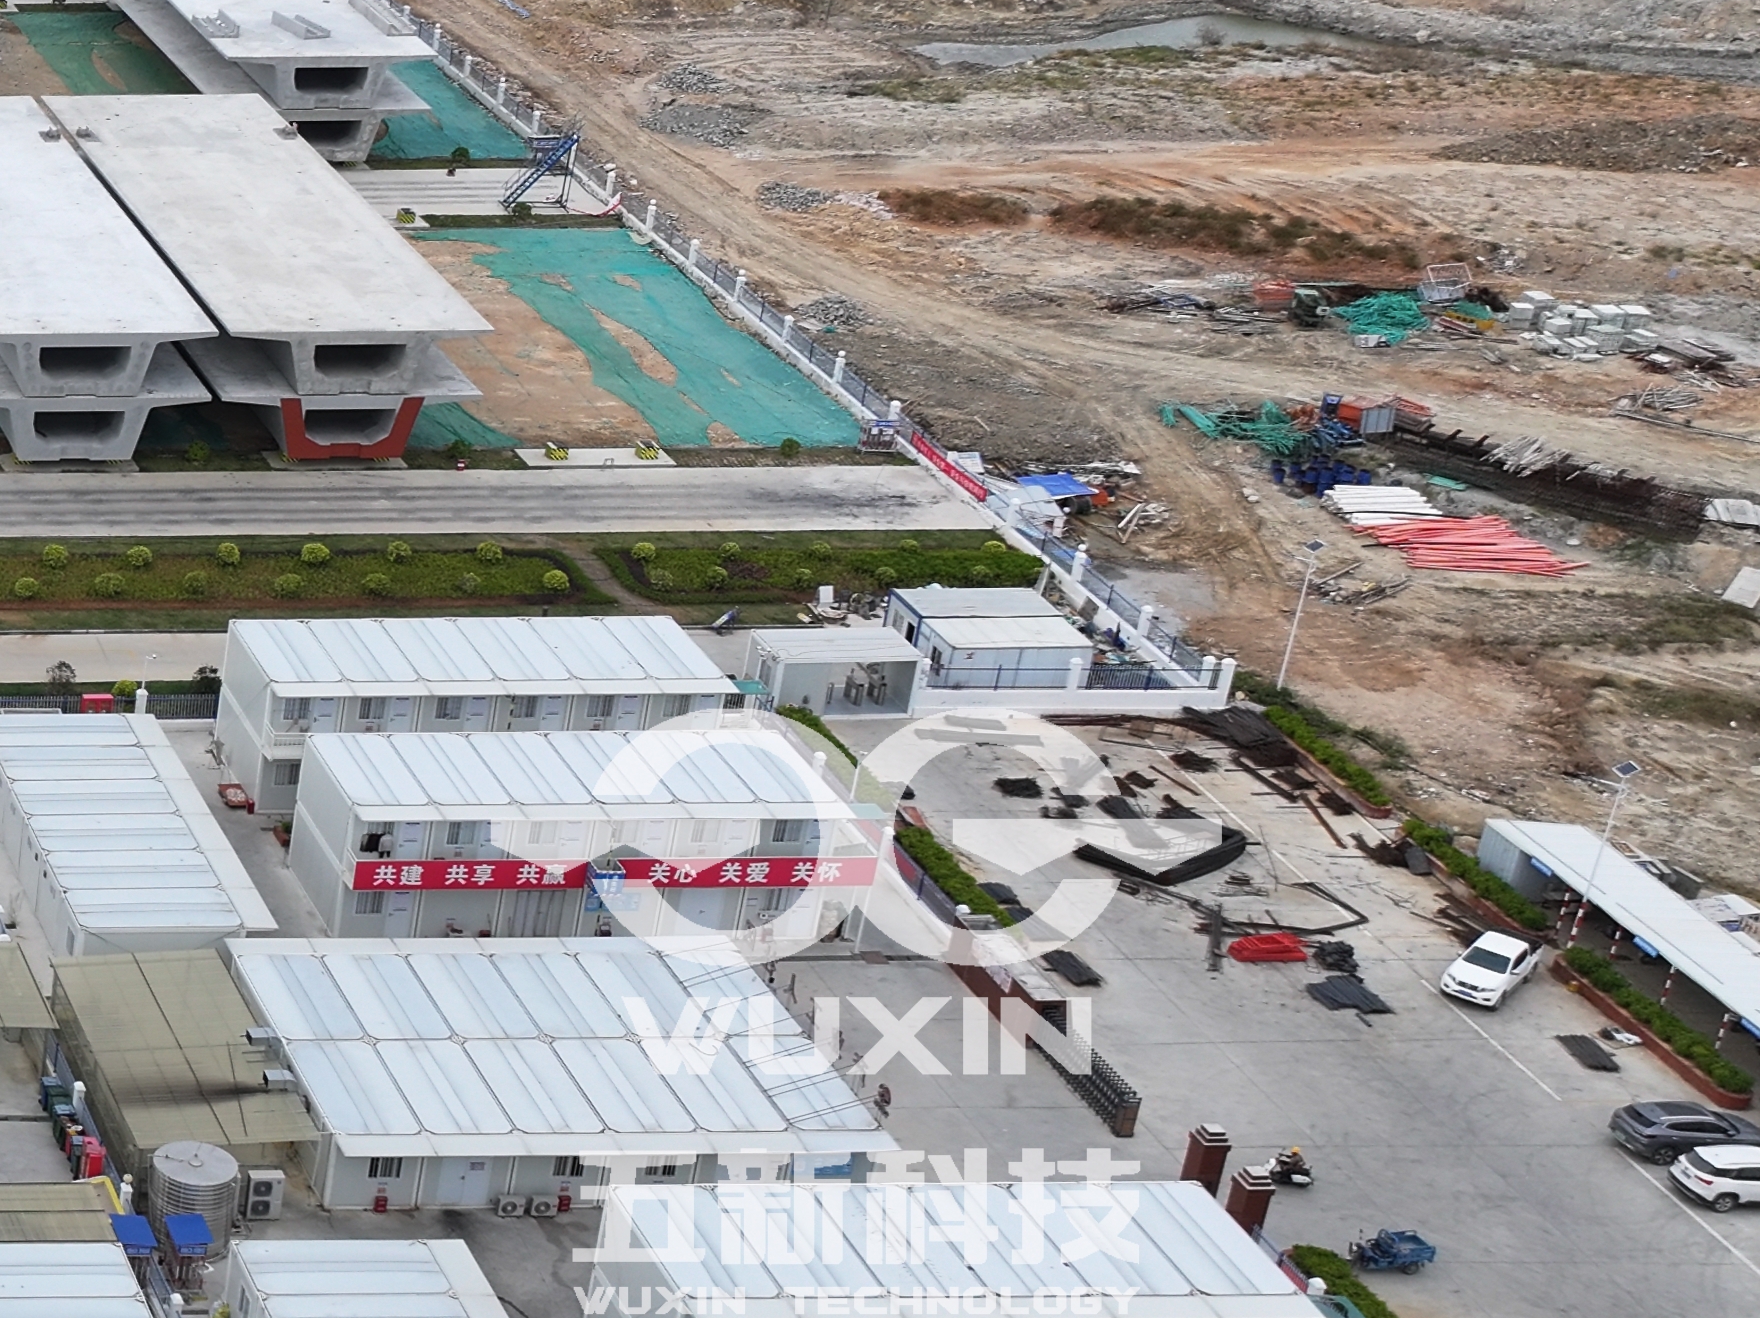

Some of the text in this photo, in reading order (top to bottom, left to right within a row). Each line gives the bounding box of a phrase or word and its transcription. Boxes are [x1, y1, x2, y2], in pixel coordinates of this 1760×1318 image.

[373, 861, 842, 886] 共建 共享 共赢 关心 关爱 关怀
